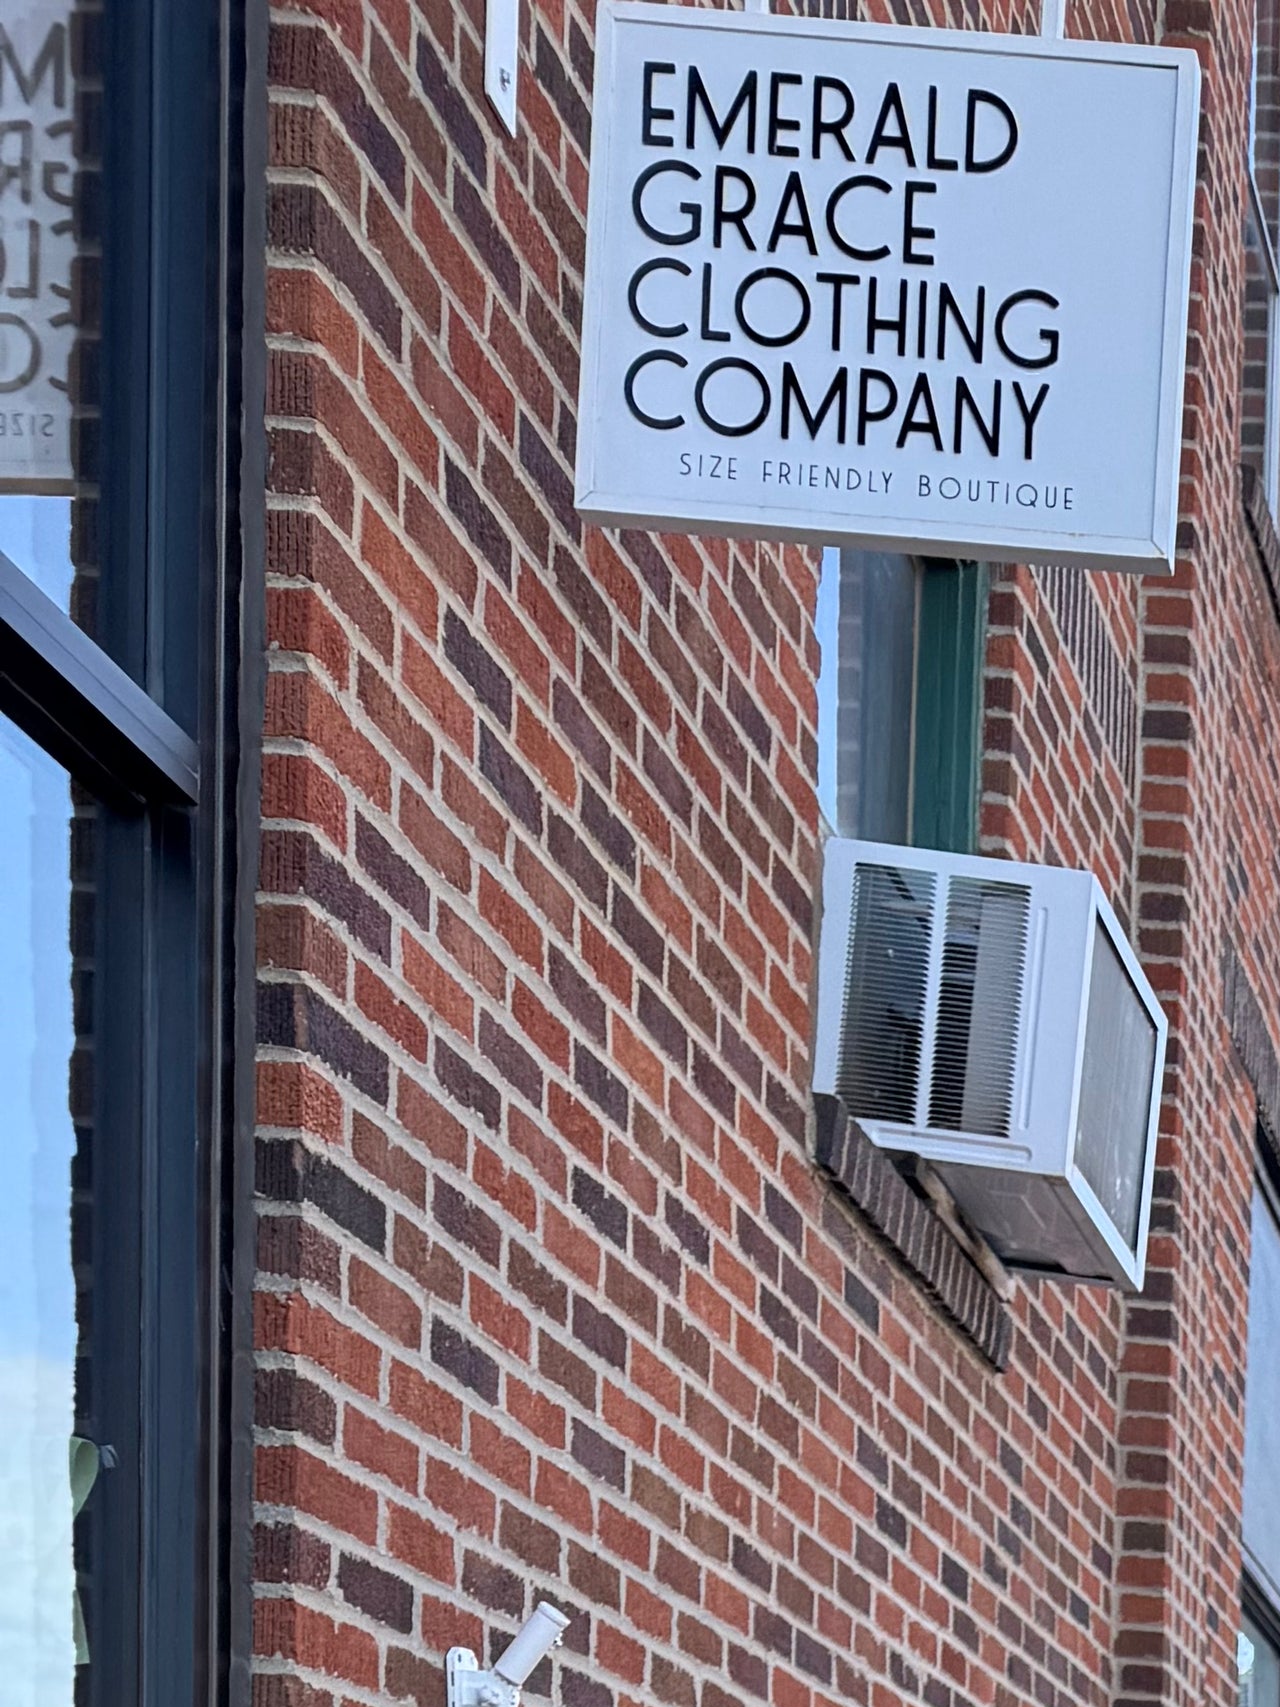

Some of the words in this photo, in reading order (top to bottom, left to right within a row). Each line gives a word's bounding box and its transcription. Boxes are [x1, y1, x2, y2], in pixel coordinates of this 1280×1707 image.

[641, 61, 1019, 173] EMERALD
[631, 159, 938, 266] GRACE
[627, 257, 1060, 370] CLOTHING
[623, 348, 1050, 460] COMPANY
[679, 453, 738, 480] SIZE
[762, 461, 893, 494] FRIENDLY
[919, 474, 1074, 510] BOUTIQUE
